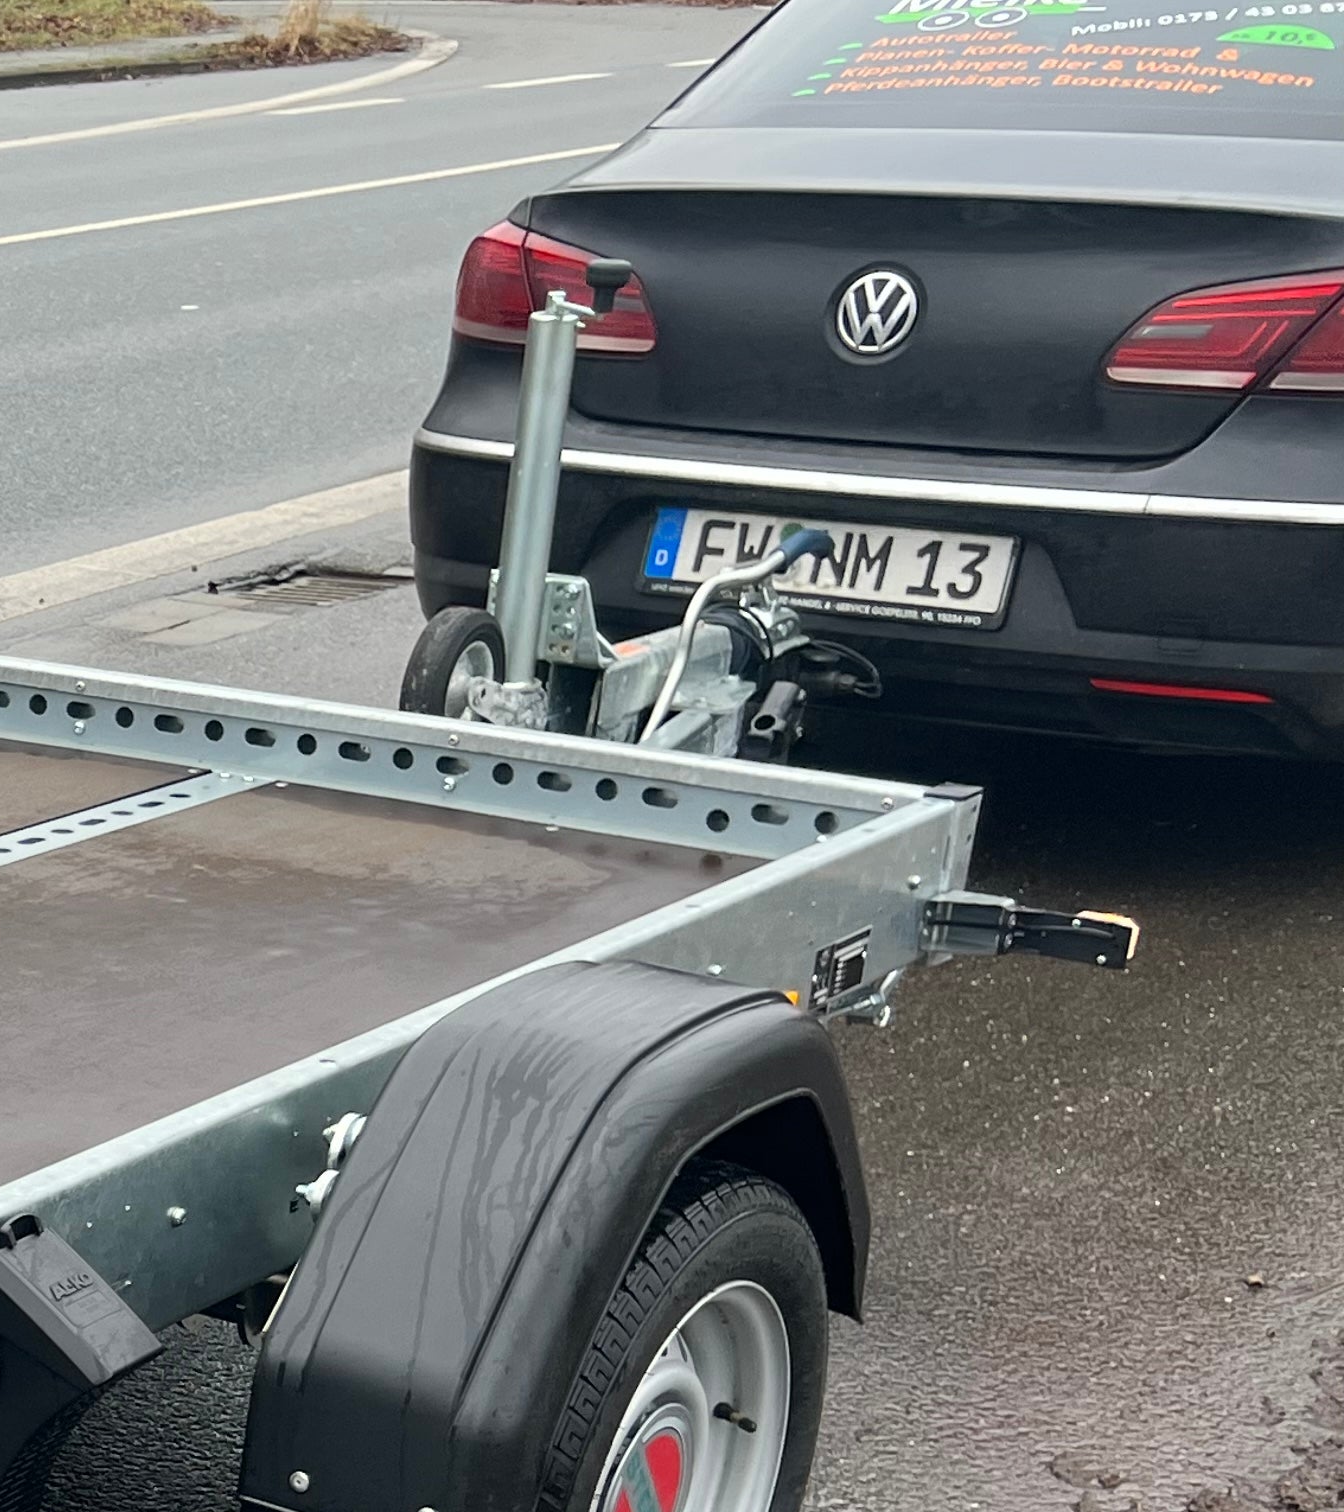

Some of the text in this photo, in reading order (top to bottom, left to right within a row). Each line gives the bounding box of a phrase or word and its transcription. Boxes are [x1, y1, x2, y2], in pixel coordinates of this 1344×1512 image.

[870, 31, 1018, 47] Autotrailer
[1062, 43, 1202, 58] Motorrad
[1136, 60, 1315, 87] Wohnwagen
[1052, 74, 1223, 93] Bootstrailer
[654, 549, 669, 567] D
[906, 540, 991, 600] 13
